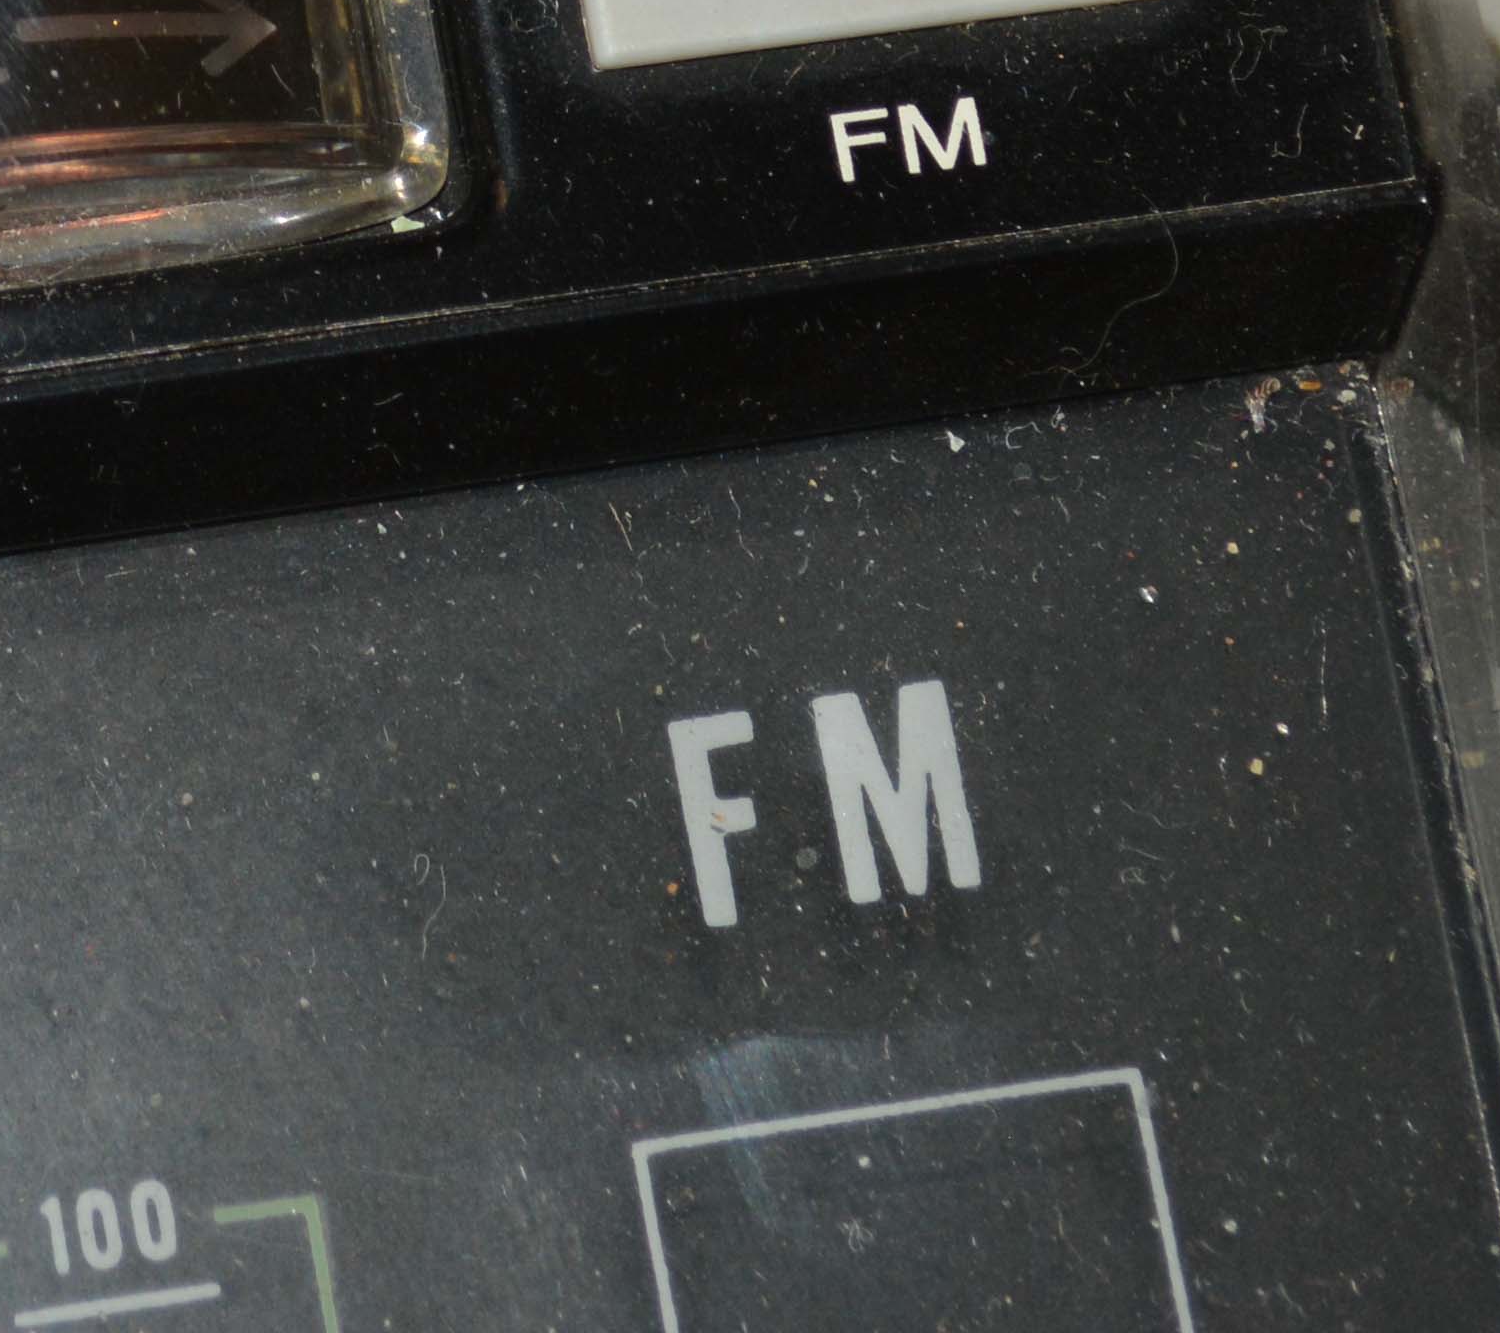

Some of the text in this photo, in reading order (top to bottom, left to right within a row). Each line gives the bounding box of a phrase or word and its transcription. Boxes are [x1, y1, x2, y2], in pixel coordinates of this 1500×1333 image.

[830, 96, 987, 182] FM
[666, 679, 981, 928] FM
[38, 1177, 178, 1277] 100
